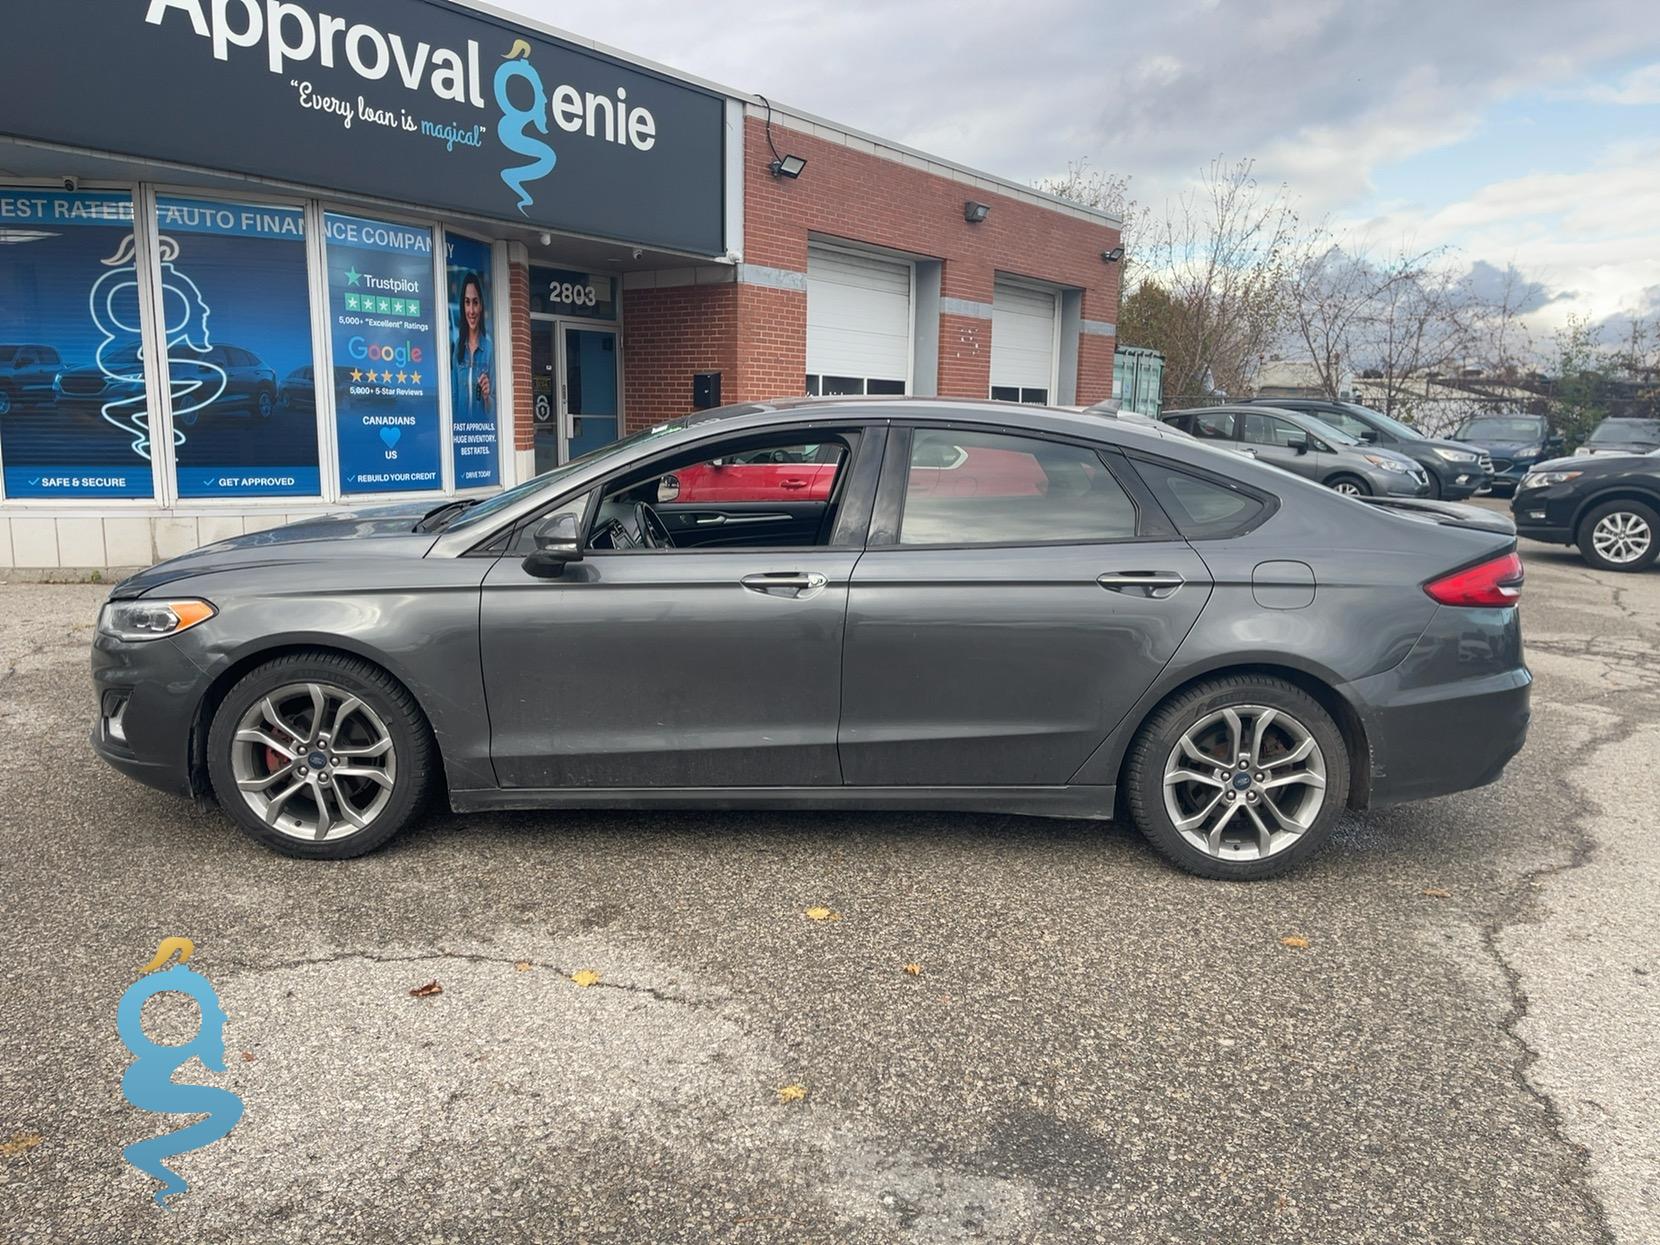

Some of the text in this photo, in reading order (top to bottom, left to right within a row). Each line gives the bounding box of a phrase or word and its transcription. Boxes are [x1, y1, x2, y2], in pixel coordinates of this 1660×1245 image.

[358, 96, 397, 128] loan
[401, 109, 417, 131] is
[166, 206, 235, 229] AUTO
[364, 274, 419, 293] Trustpilot
[550, 281, 596, 307] 2803
[339, 316, 363, 325] 5,000+
[404, 321, 429, 332] Ratings
[348, 336, 422, 368] Google
[375, 387, 395, 396] 5-Star
[396, 388, 423, 396] Reviews
[362, 416, 416, 426] CANADIANS
[453, 422, 466, 431] FAST
[453, 434, 497, 443] HUGE INVENTORY.
[385, 450, 398, 460] US
[461, 447, 473, 456] BEST
[357, 472, 437, 482] REBUILD YOUR CREDIT
[465, 471, 478, 479] DRIVE
[41, 477, 127, 487] SAFE & SECURE
[218, 477, 295, 487] GET APPROVED
